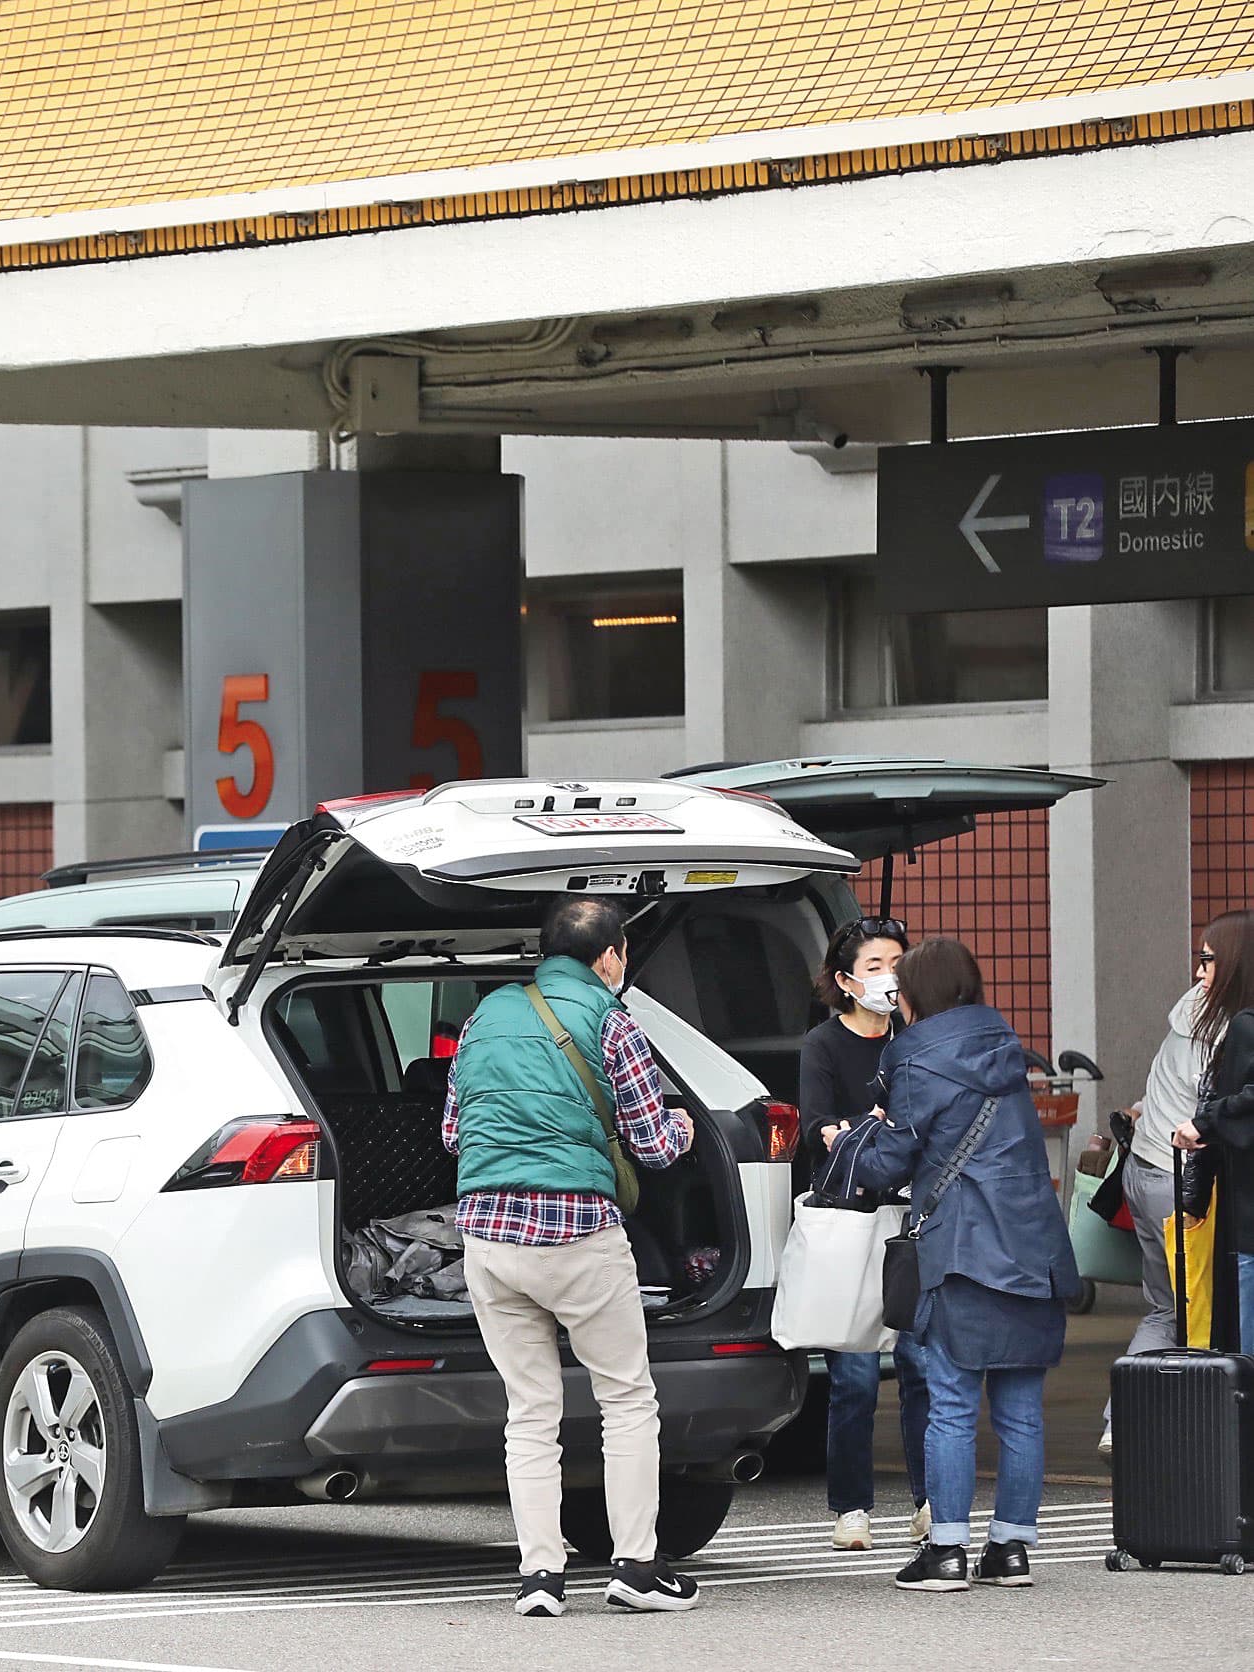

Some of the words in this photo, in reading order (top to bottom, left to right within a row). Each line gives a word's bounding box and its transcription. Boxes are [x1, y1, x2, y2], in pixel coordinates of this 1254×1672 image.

[1053, 497, 1095, 540] T2
[1119, 471, 1215, 520] 國內線
[1119, 528, 1205, 553] Domestic
[215, 674, 274, 818] 5
[410, 671, 484, 788] 5
